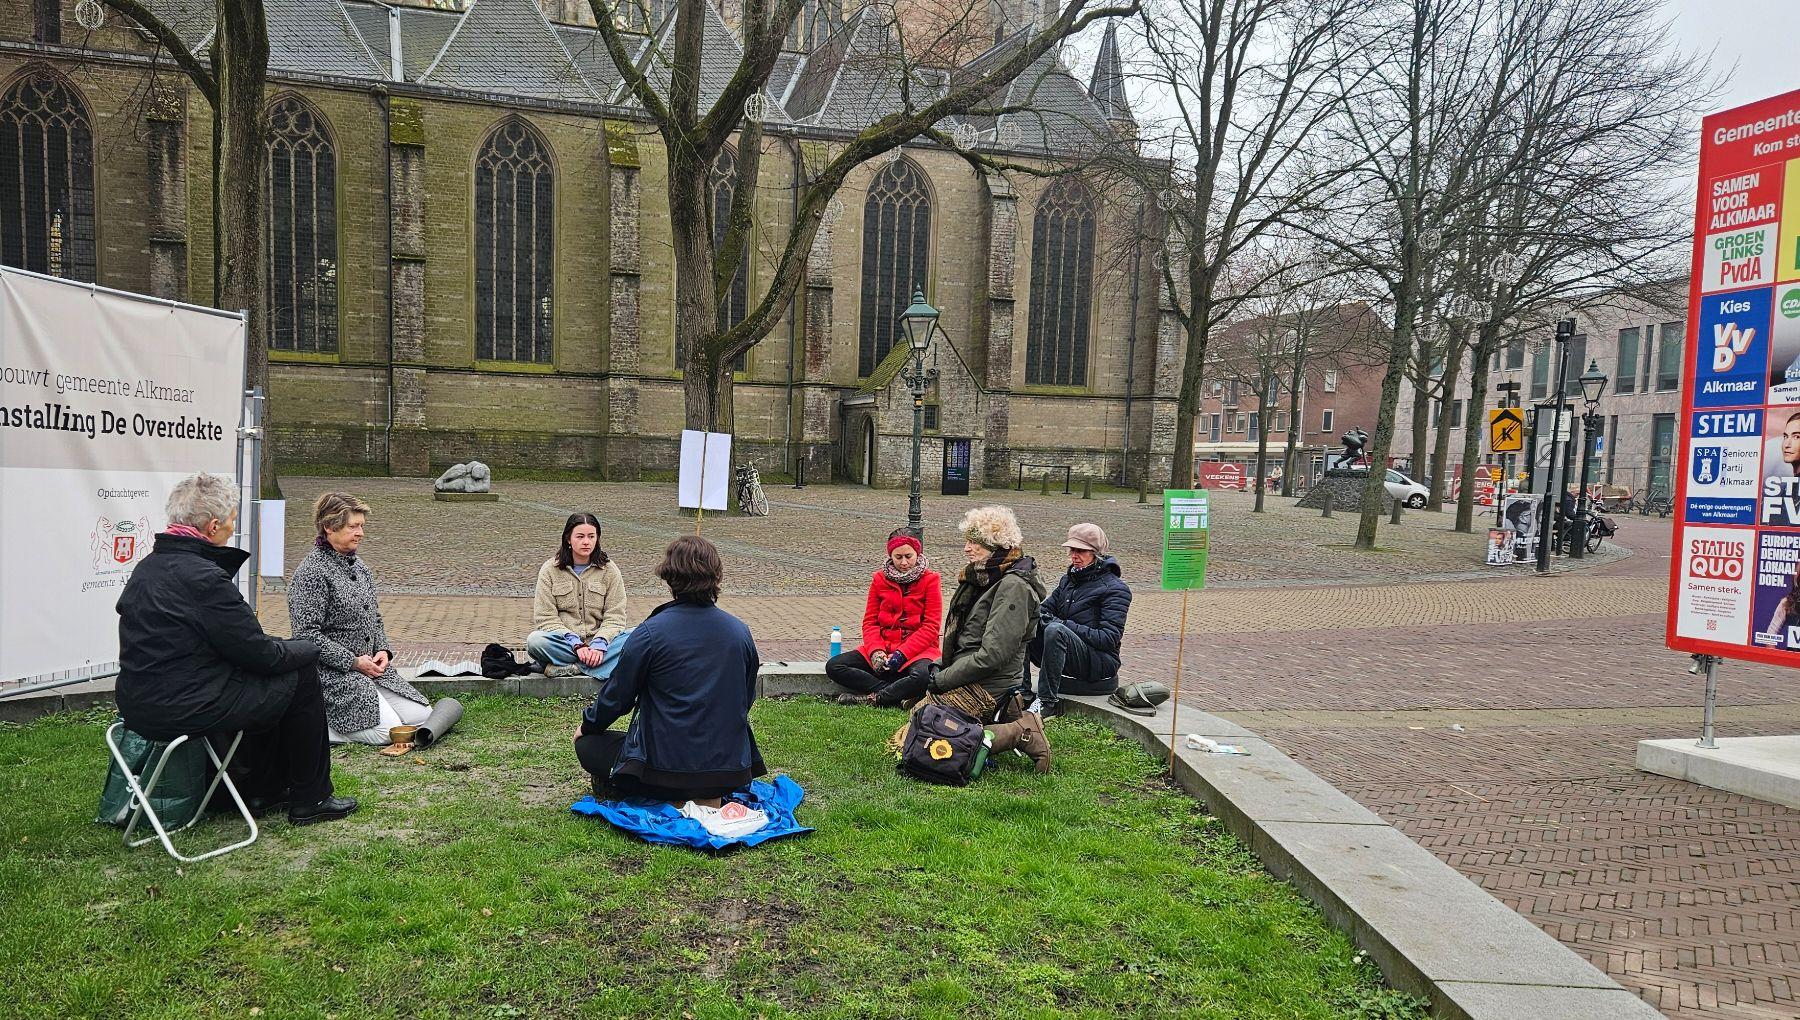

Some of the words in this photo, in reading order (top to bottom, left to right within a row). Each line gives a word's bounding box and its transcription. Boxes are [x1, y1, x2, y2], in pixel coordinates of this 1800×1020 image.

[1753, 140, 1783, 156] Kom
[1786, 134, 1800, 148] st
[1713, 172, 1760, 196] SAMEN
[1712, 192, 1749, 212] VOOR
[1710, 203, 1776, 230] ALKMAAR
[1714, 230, 1765, 250] GROEN
[1722, 243, 1764, 261] LINKS
[1720, 257, 1762, 285] PvdA
[1720, 300, 1751, 315] Kies
[56, 374, 130, 396] gemeente
[134, 379, 194, 403] Alkmaar
[1703, 380, 1757, 394] Alkmaar
[101, 409, 127, 435] De
[133, 412, 223, 441] Overdekte
[1698, 413, 1756, 435] STEM
[1697, 448, 1718, 457] SPA
[1722, 448, 1758, 458] Senioren
[1721, 463, 1743, 474] Partij
[1720, 477, 1754, 486] Alkmaar
[1764, 476, 1800, 497] ST
[1699, 503, 1714, 511] enige
[1714, 503, 1752, 513] ouderenpartij
[1691, 539, 1745, 557] STATUS
[1691, 557, 1742, 578] QUO
[81, 578, 116, 592] gemeente
[1688, 582, 1716, 592] Samen
[1718, 585, 1742, 595] sterk.
[1759, 573, 1787, 587] DOEN.
